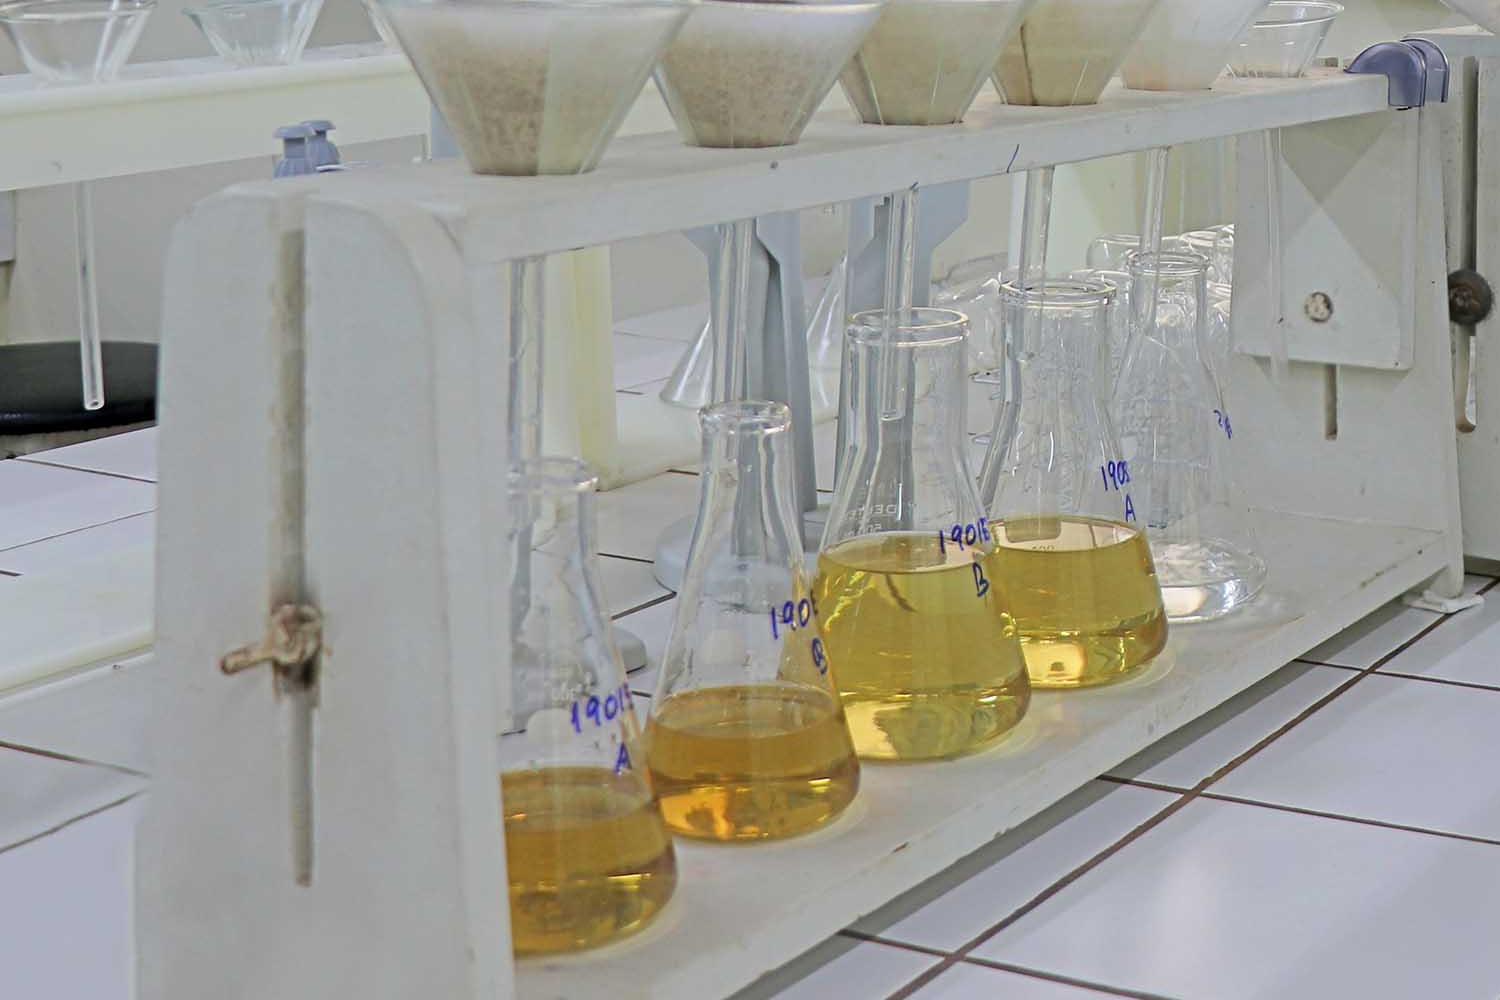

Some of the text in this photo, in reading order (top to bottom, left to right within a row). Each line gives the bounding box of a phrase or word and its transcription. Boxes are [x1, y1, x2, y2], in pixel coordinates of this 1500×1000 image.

[1125, 493, 1137, 522] A
[972, 561, 990, 598] B
[614, 741, 633, 776] A
